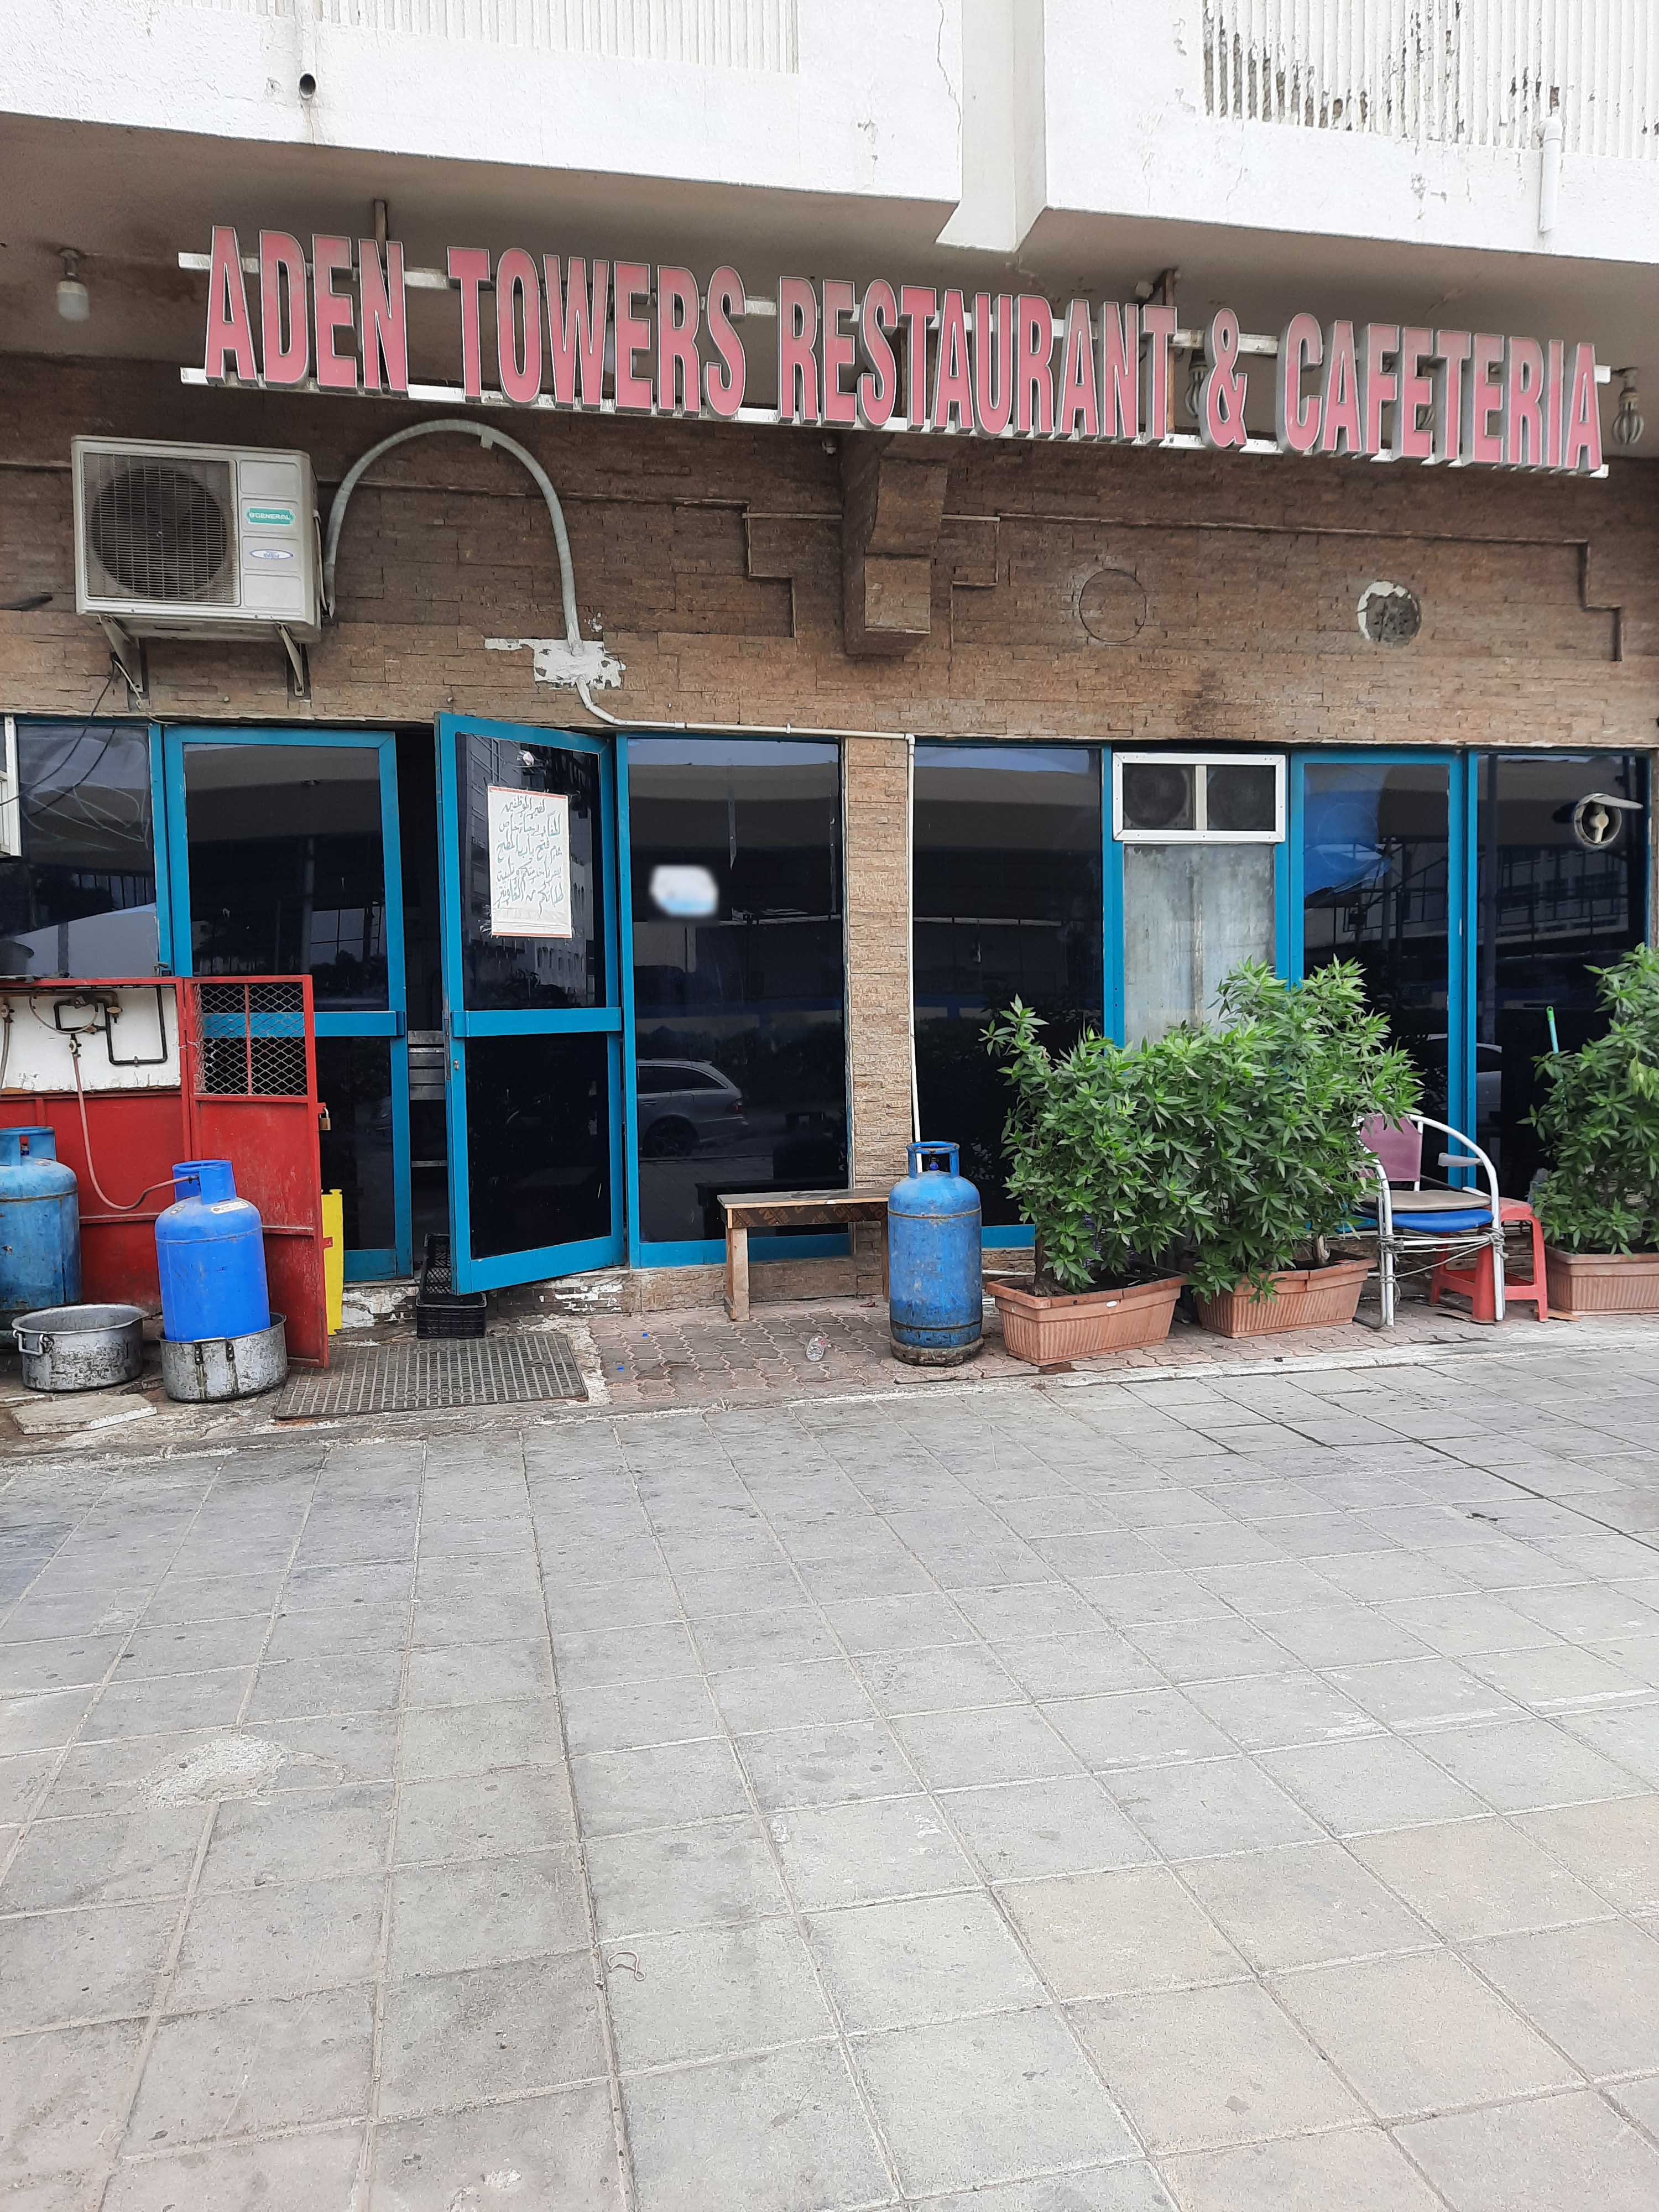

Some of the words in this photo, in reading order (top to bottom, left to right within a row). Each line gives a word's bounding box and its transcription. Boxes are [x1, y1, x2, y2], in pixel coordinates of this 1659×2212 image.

[205, 225, 409, 394] ADEN
[447, 246, 746, 419] TOWERS
[778, 275, 1177, 443] RESTAURANT
[1200, 307, 1248, 451] &
[1278, 312, 1603, 471] CAFETERIA
